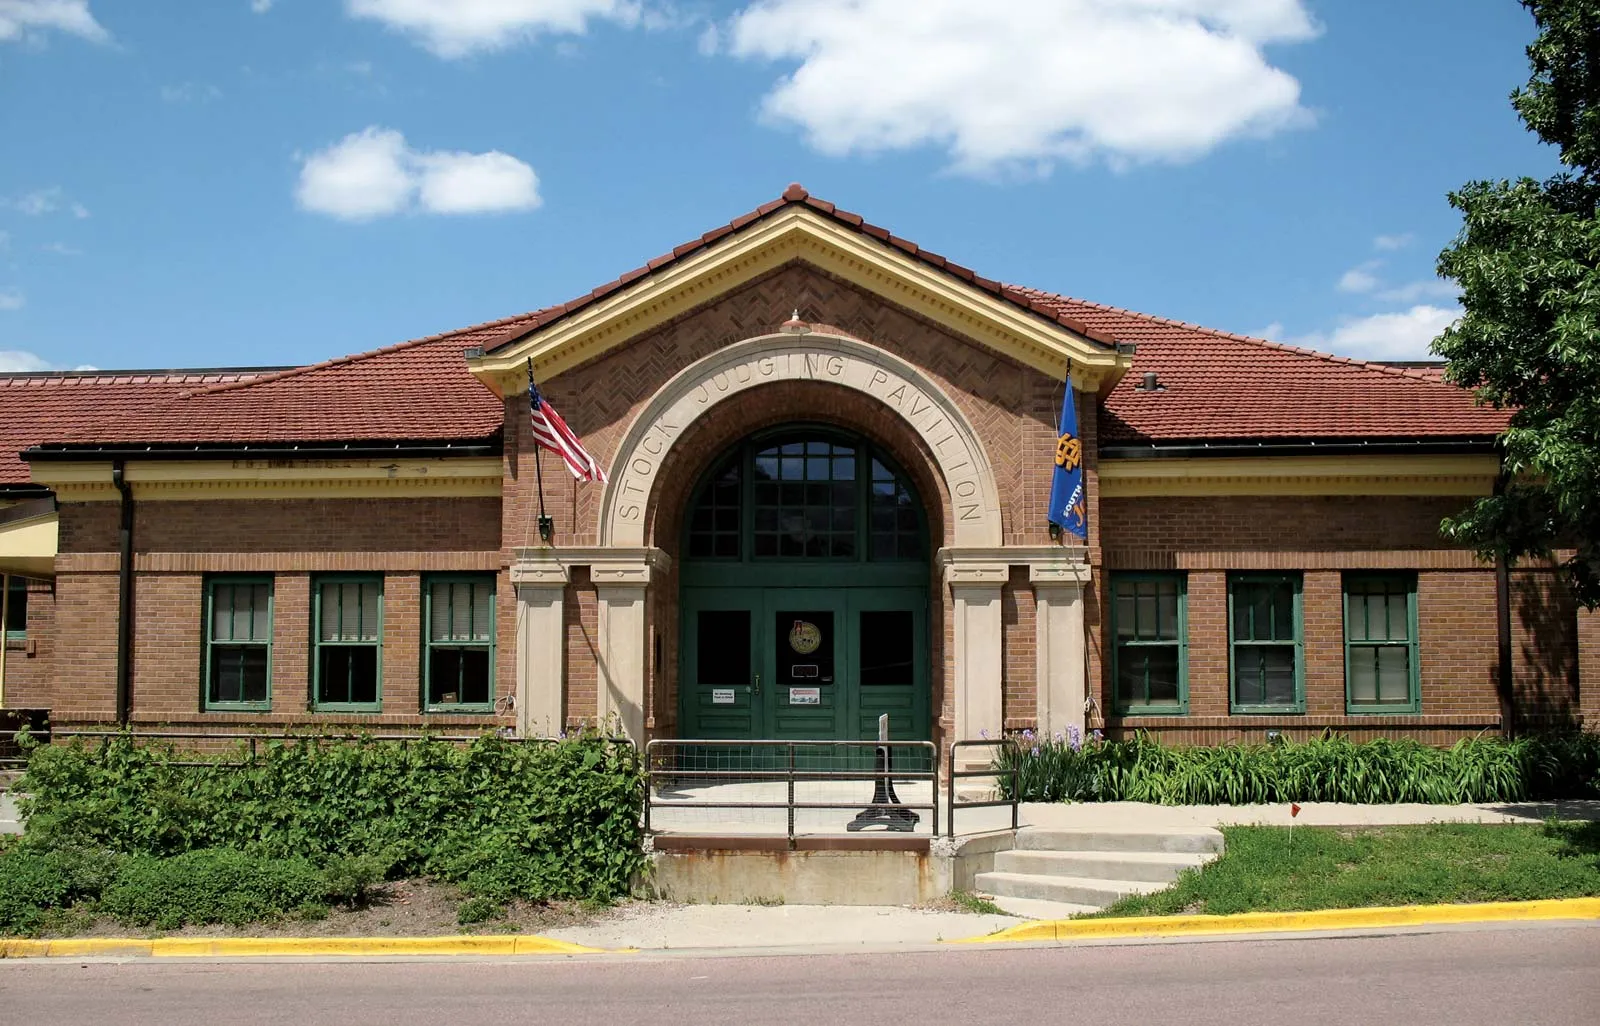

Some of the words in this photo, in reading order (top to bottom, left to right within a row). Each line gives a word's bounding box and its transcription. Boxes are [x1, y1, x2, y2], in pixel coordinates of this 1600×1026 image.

[620, 417, 678, 519] STOCK
[697, 353, 845, 404] JUDGING
[868, 370, 981, 521] PAVILION
[1062, 484, 1082, 518] SOUTH
